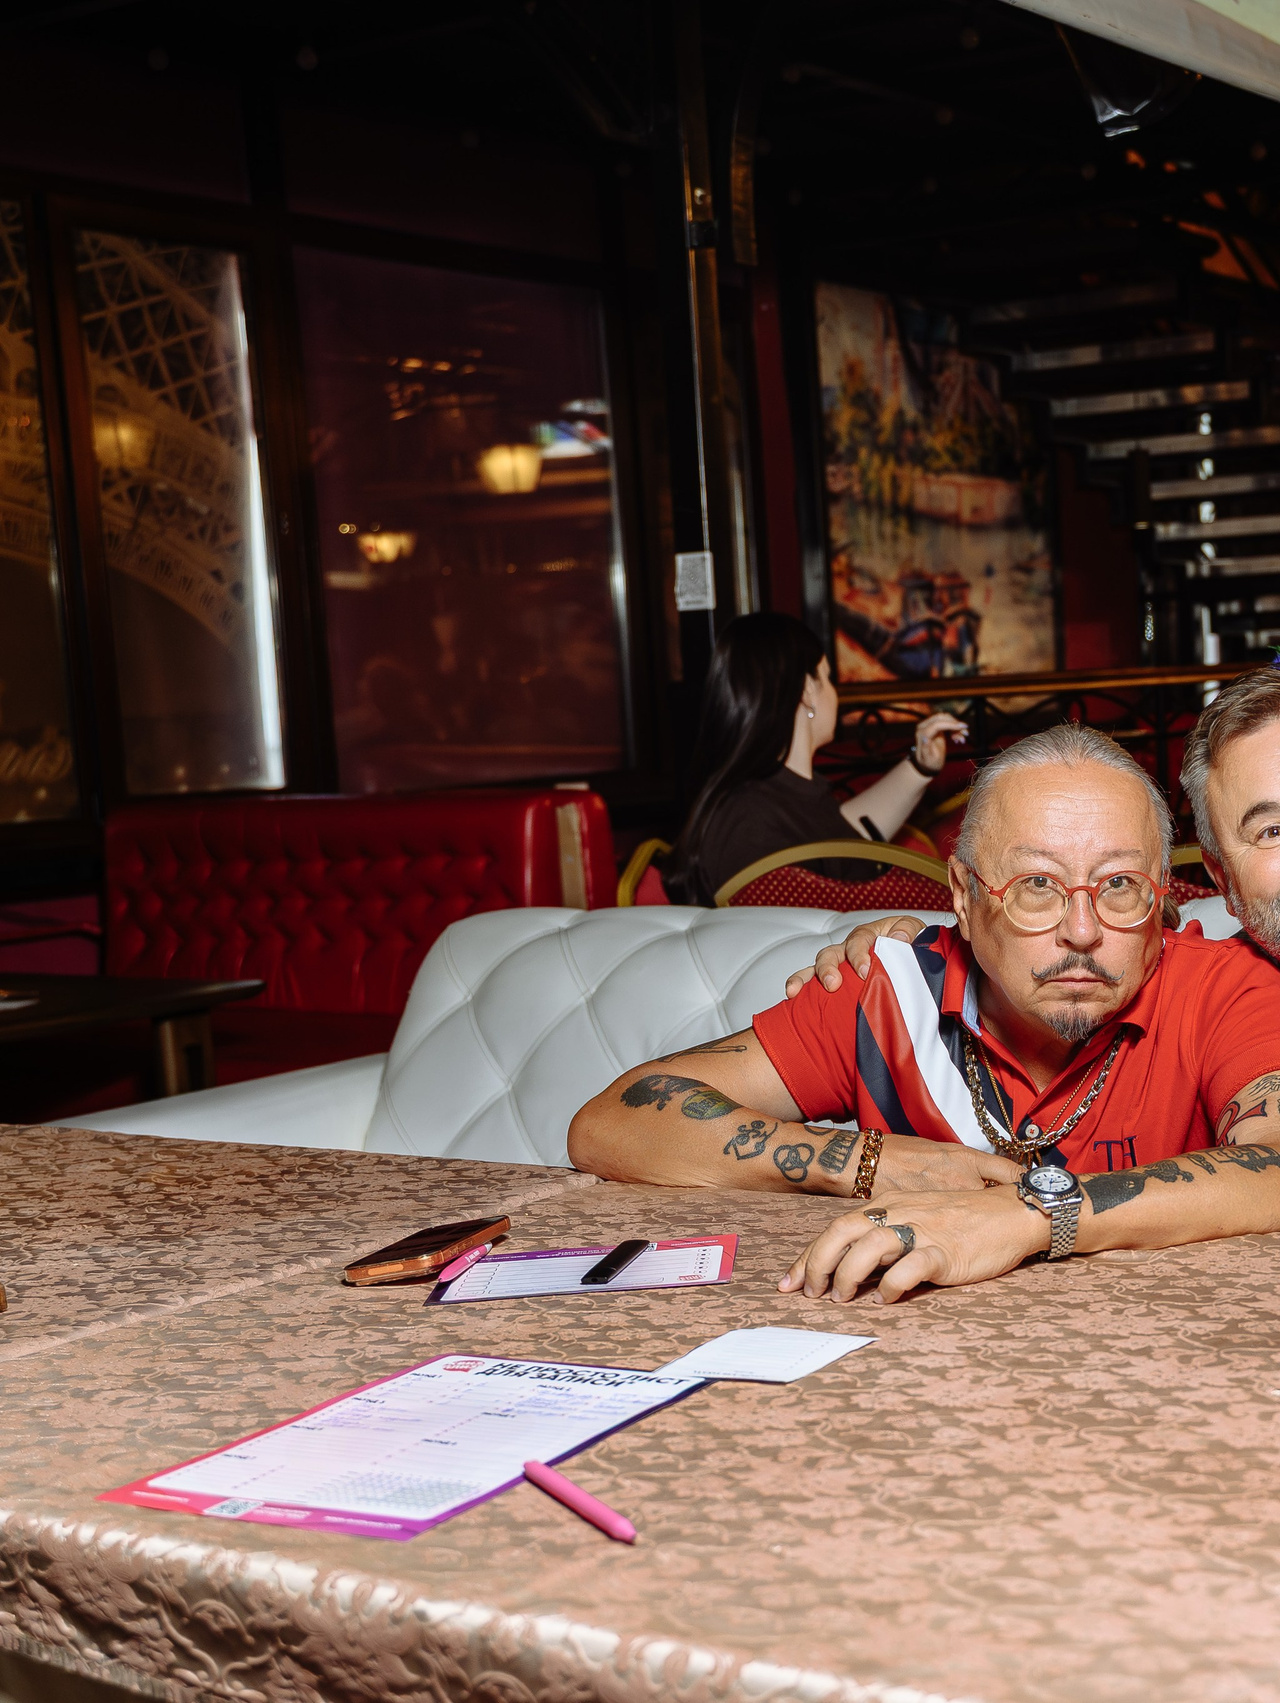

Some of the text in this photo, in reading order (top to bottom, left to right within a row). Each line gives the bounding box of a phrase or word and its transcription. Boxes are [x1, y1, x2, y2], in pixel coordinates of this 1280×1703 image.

[475, 1368, 525, 1378] ДЛЯ
[491, 1362, 526, 1371] НЕ
[525, 1365, 620, 1379] ПРОСТО
[620, 1374, 690, 1385] ЛИСТ
